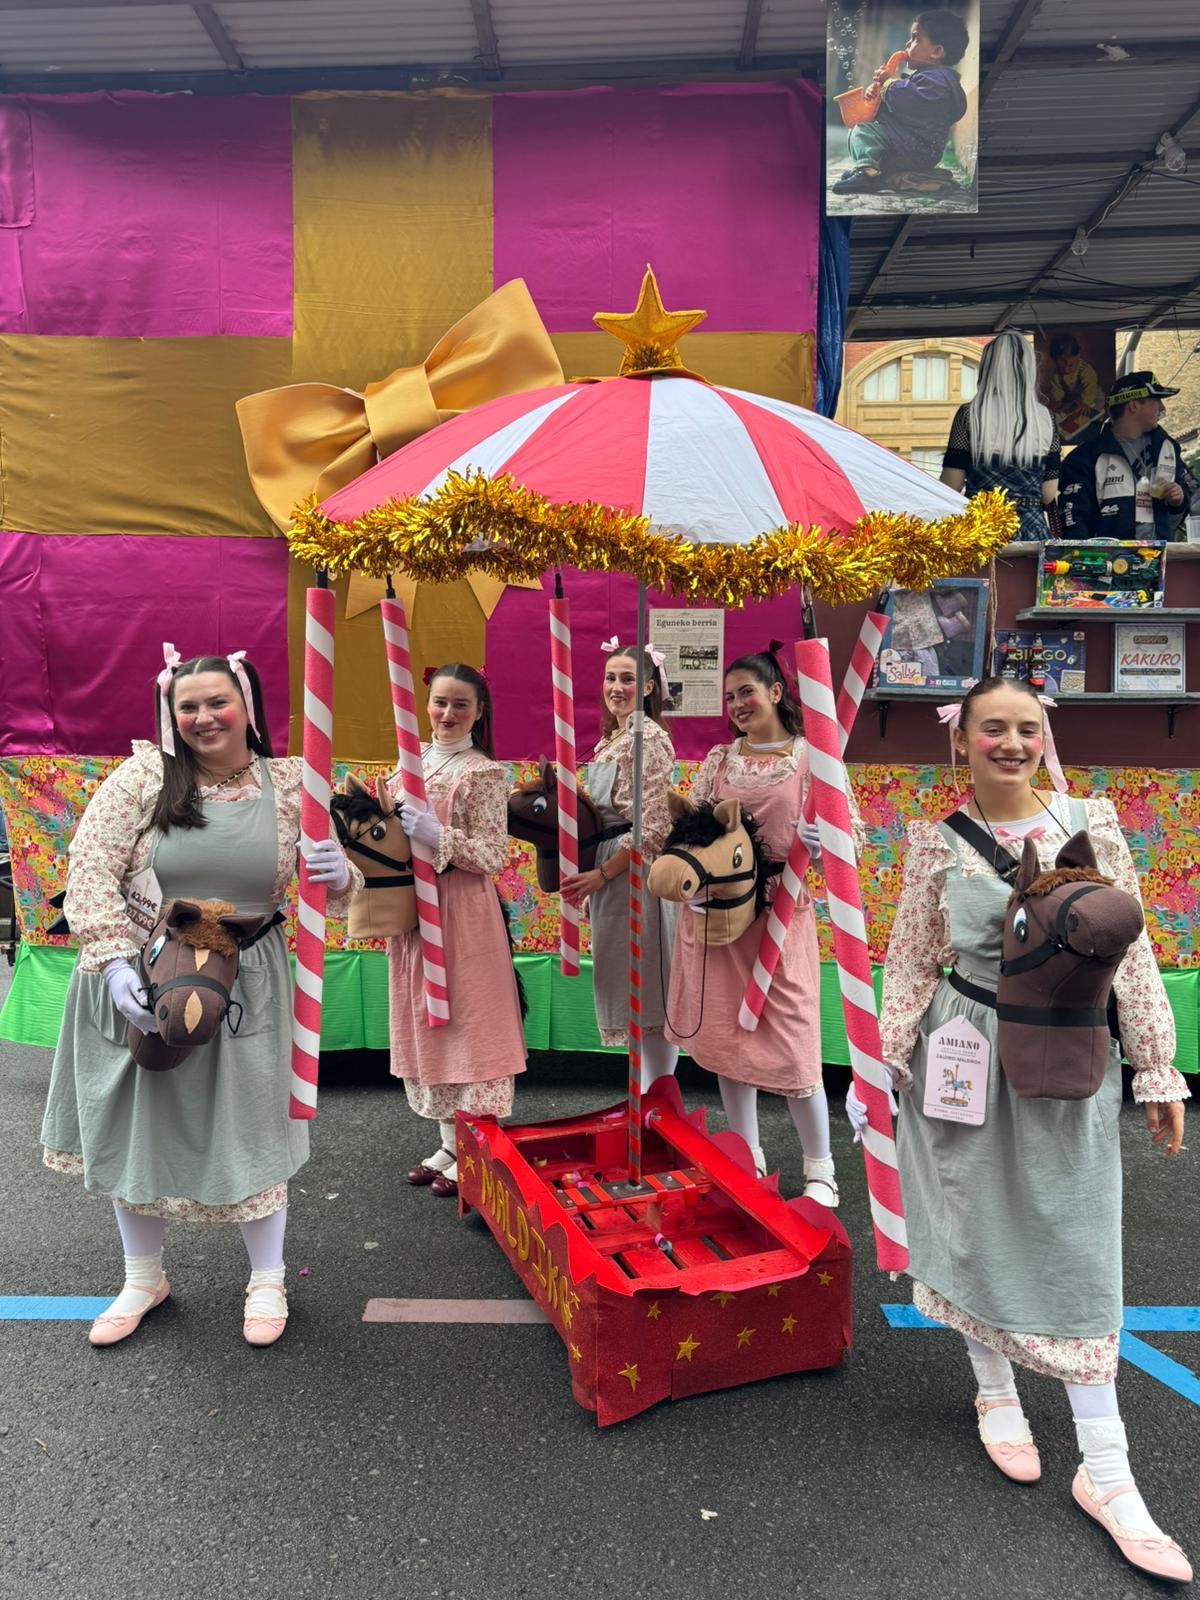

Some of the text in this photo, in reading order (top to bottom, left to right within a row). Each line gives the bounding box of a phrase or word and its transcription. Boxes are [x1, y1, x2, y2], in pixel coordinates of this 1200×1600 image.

[656, 619, 690, 628] Eguneko
[1016, 649, 1067, 661] BIGO
[1120, 653, 1181, 666] KAKURO
[887, 664, 917, 682] Sally
[939, 1036, 980, 1051] AMIANO
